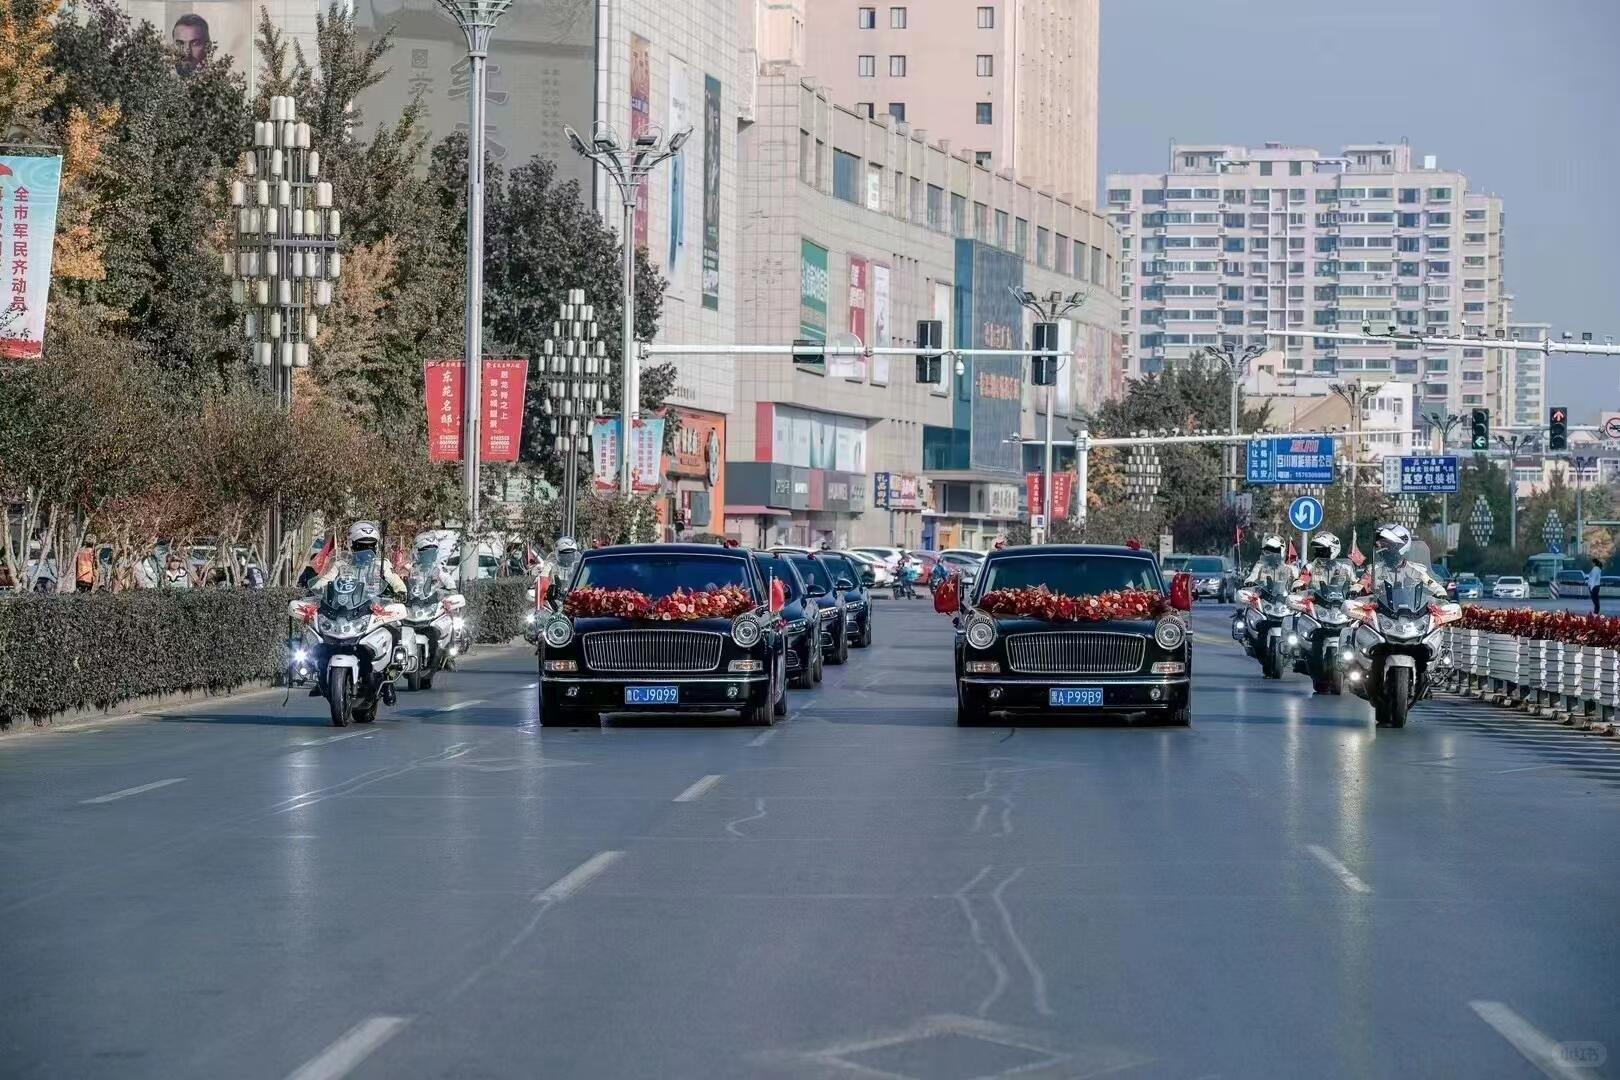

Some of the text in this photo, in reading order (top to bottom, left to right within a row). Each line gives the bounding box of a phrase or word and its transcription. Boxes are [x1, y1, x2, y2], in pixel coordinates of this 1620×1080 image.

[11, 186, 29, 312] 全市军民齐动员
[1403, 473, 1456, 485] 真空包装机
